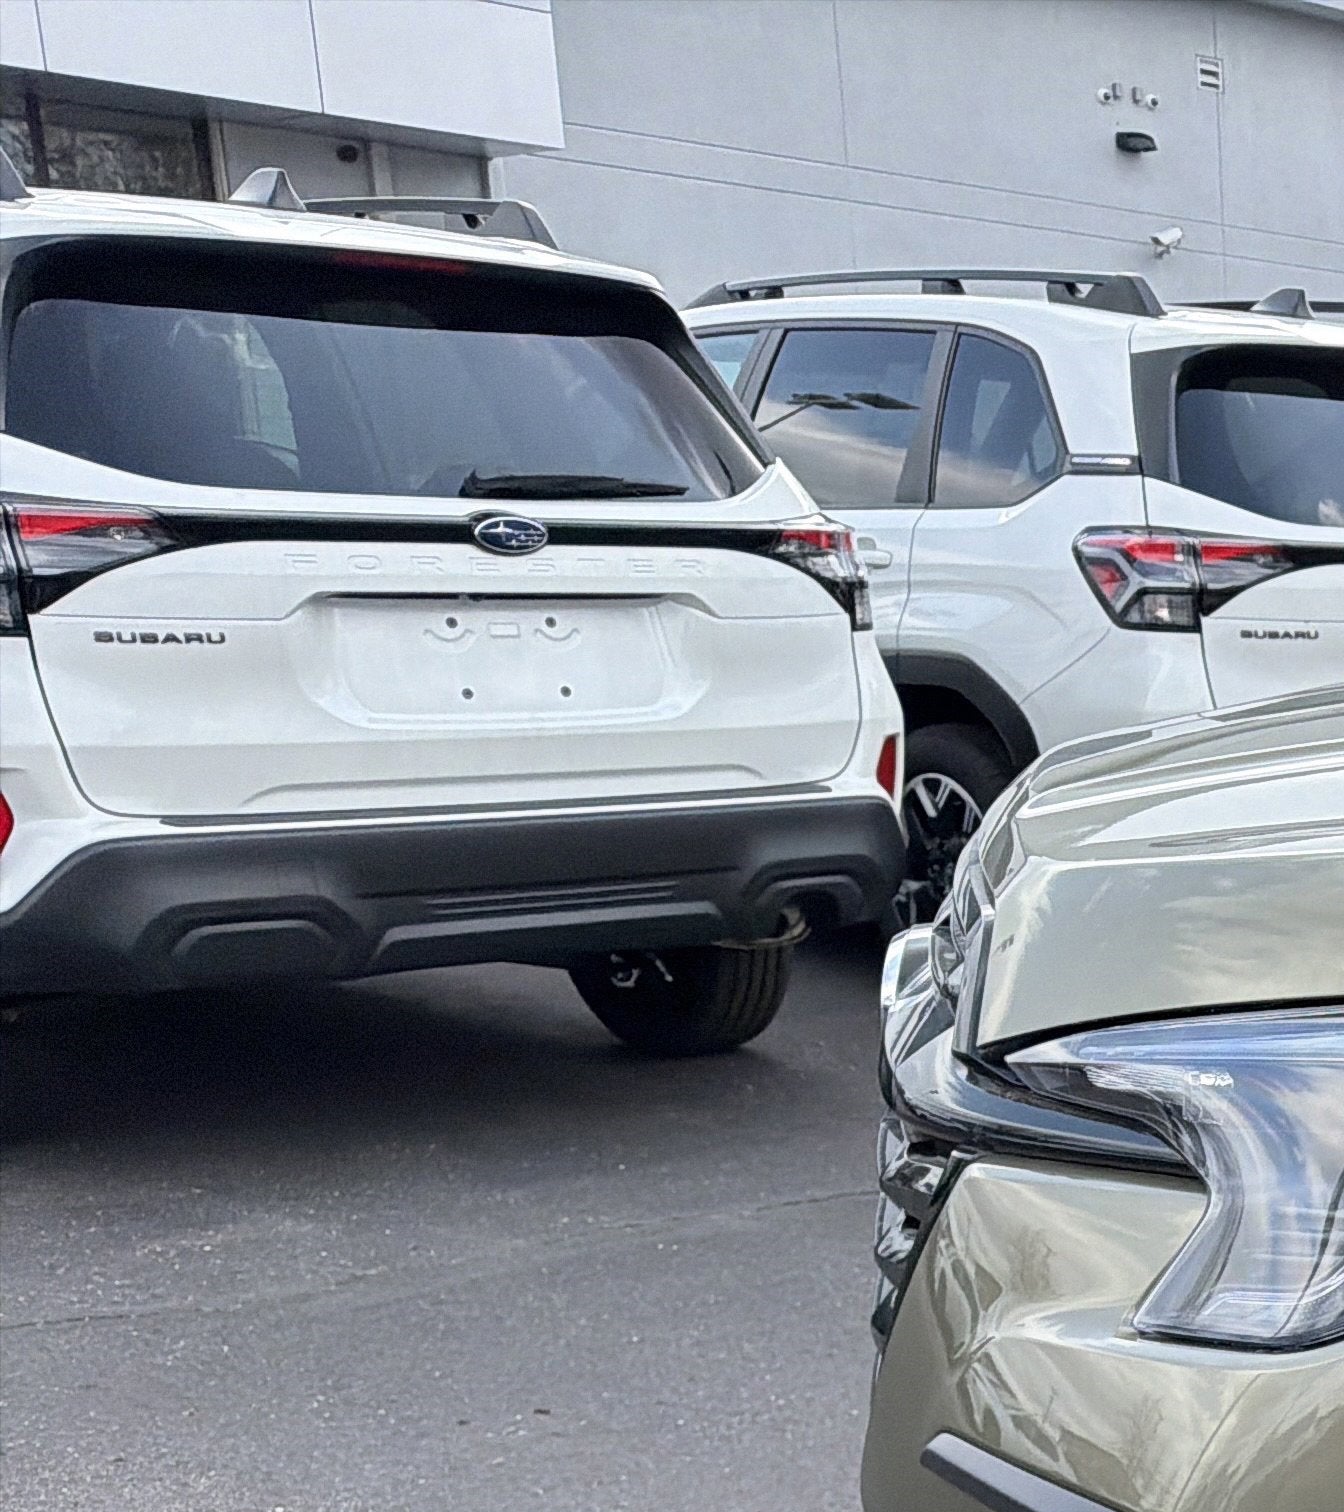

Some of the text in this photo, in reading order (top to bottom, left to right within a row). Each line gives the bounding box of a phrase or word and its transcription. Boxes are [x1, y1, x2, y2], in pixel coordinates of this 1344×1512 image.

[283, 553, 711, 575] FORESTER
[93, 630, 226, 644] SUBARU
[1240, 629, 1319, 640] SUBARU
